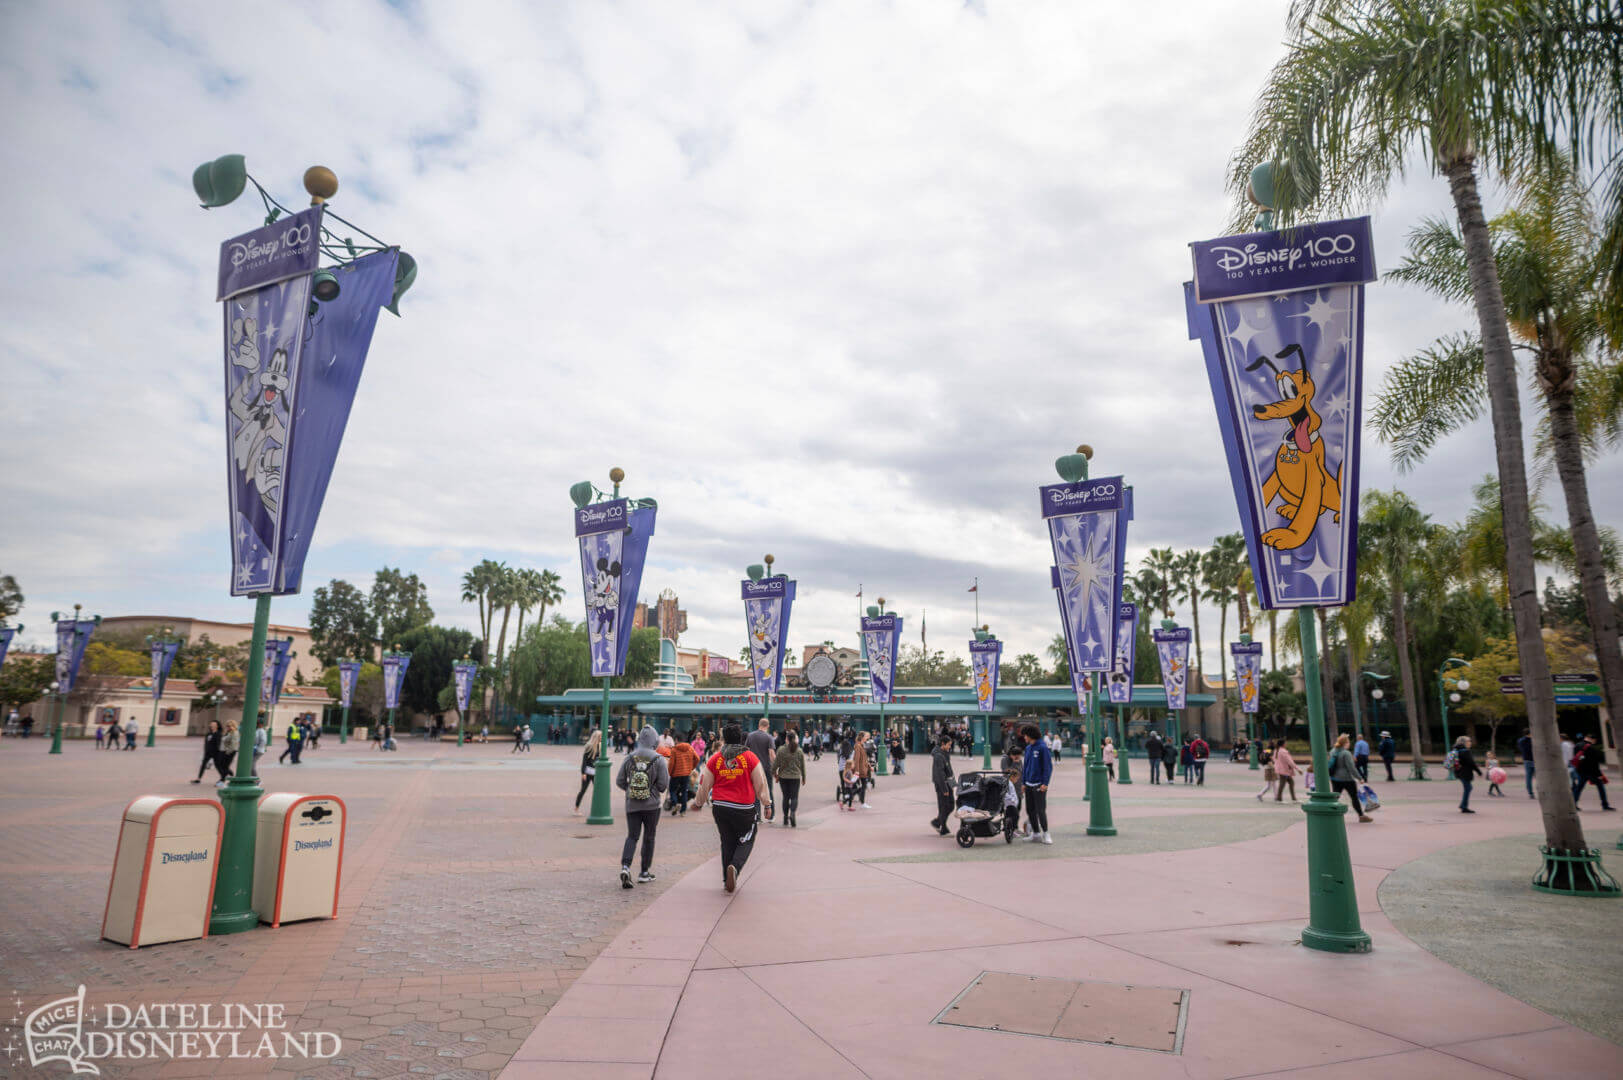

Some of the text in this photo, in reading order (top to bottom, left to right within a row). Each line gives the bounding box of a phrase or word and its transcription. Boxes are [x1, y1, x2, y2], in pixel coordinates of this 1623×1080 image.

[228, 223, 311, 266] Disney 100
[1210, 234, 1356, 271] Disney 100
[1227, 271, 1244, 280] 100
[1250, 265, 1285, 277] YEARS
[1311, 256, 1356, 268] WONDER
[1047, 484, 1116, 503] Disney 100
[579, 509, 607, 524] Disney
[606, 506, 623, 518] 100
[694, 695, 907, 705] DISNEY CALIORNIA ADVENRE
[294, 837, 333, 851] Disneyland
[161, 849, 208, 864] Disneyland
